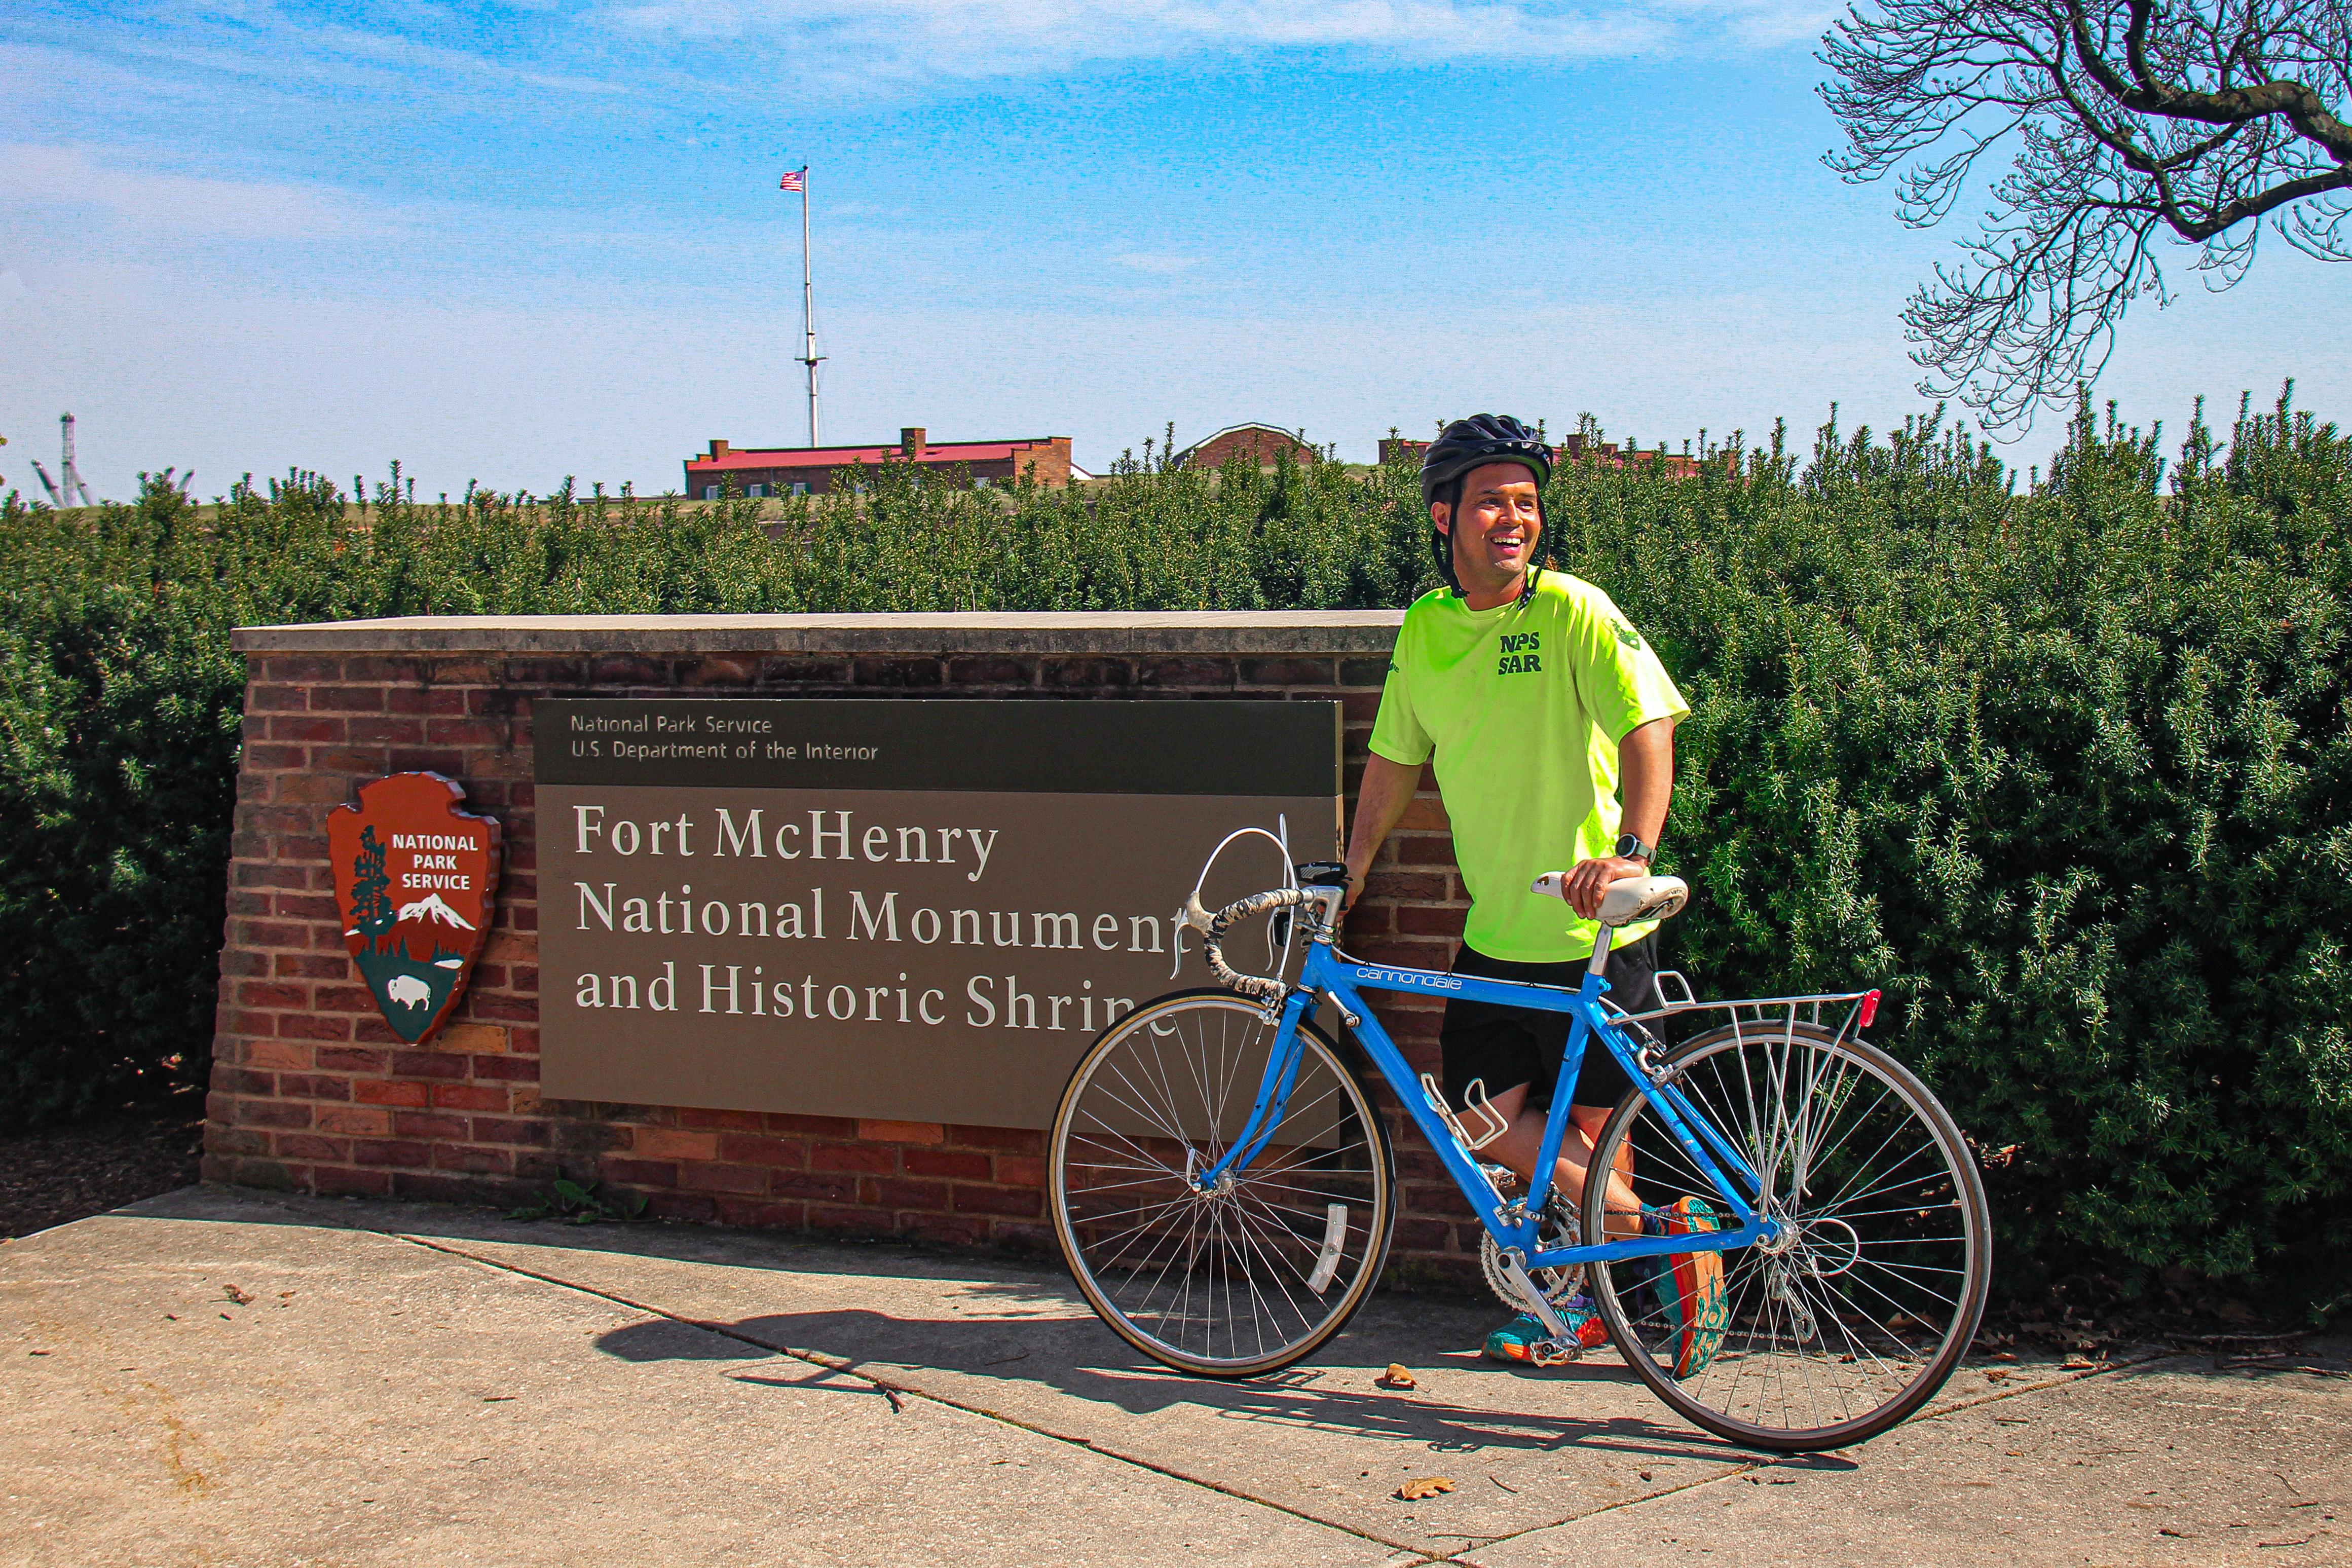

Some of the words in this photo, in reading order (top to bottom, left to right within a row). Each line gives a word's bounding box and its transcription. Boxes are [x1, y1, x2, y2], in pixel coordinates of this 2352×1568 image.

[1500, 631, 1540, 654] NPS
[1498, 654, 1542, 676] SAR
[571, 714, 648, 733] National
[657, 715, 696, 733] Park
[706, 715, 772, 734] Service
[572, 740, 604, 758] U.S.
[613, 740, 727, 762] Department
[735, 740, 757, 759] of
[767, 740, 797, 760] the
[806, 742, 879, 761] Interior
[392, 834, 479, 851] NATIONAL
[573, 805, 694, 856] Fort
[713, 808, 999, 882] McHenry
[413, 854, 458, 870] PARK
[401, 873, 471, 890] SERVICE
[574, 882, 826, 939] National
[846, 891, 1192, 953] Monument
[1356, 967, 1463, 990] cannondale
[576, 961, 679, 1011] and
[698, 964, 946, 1025] Historic
